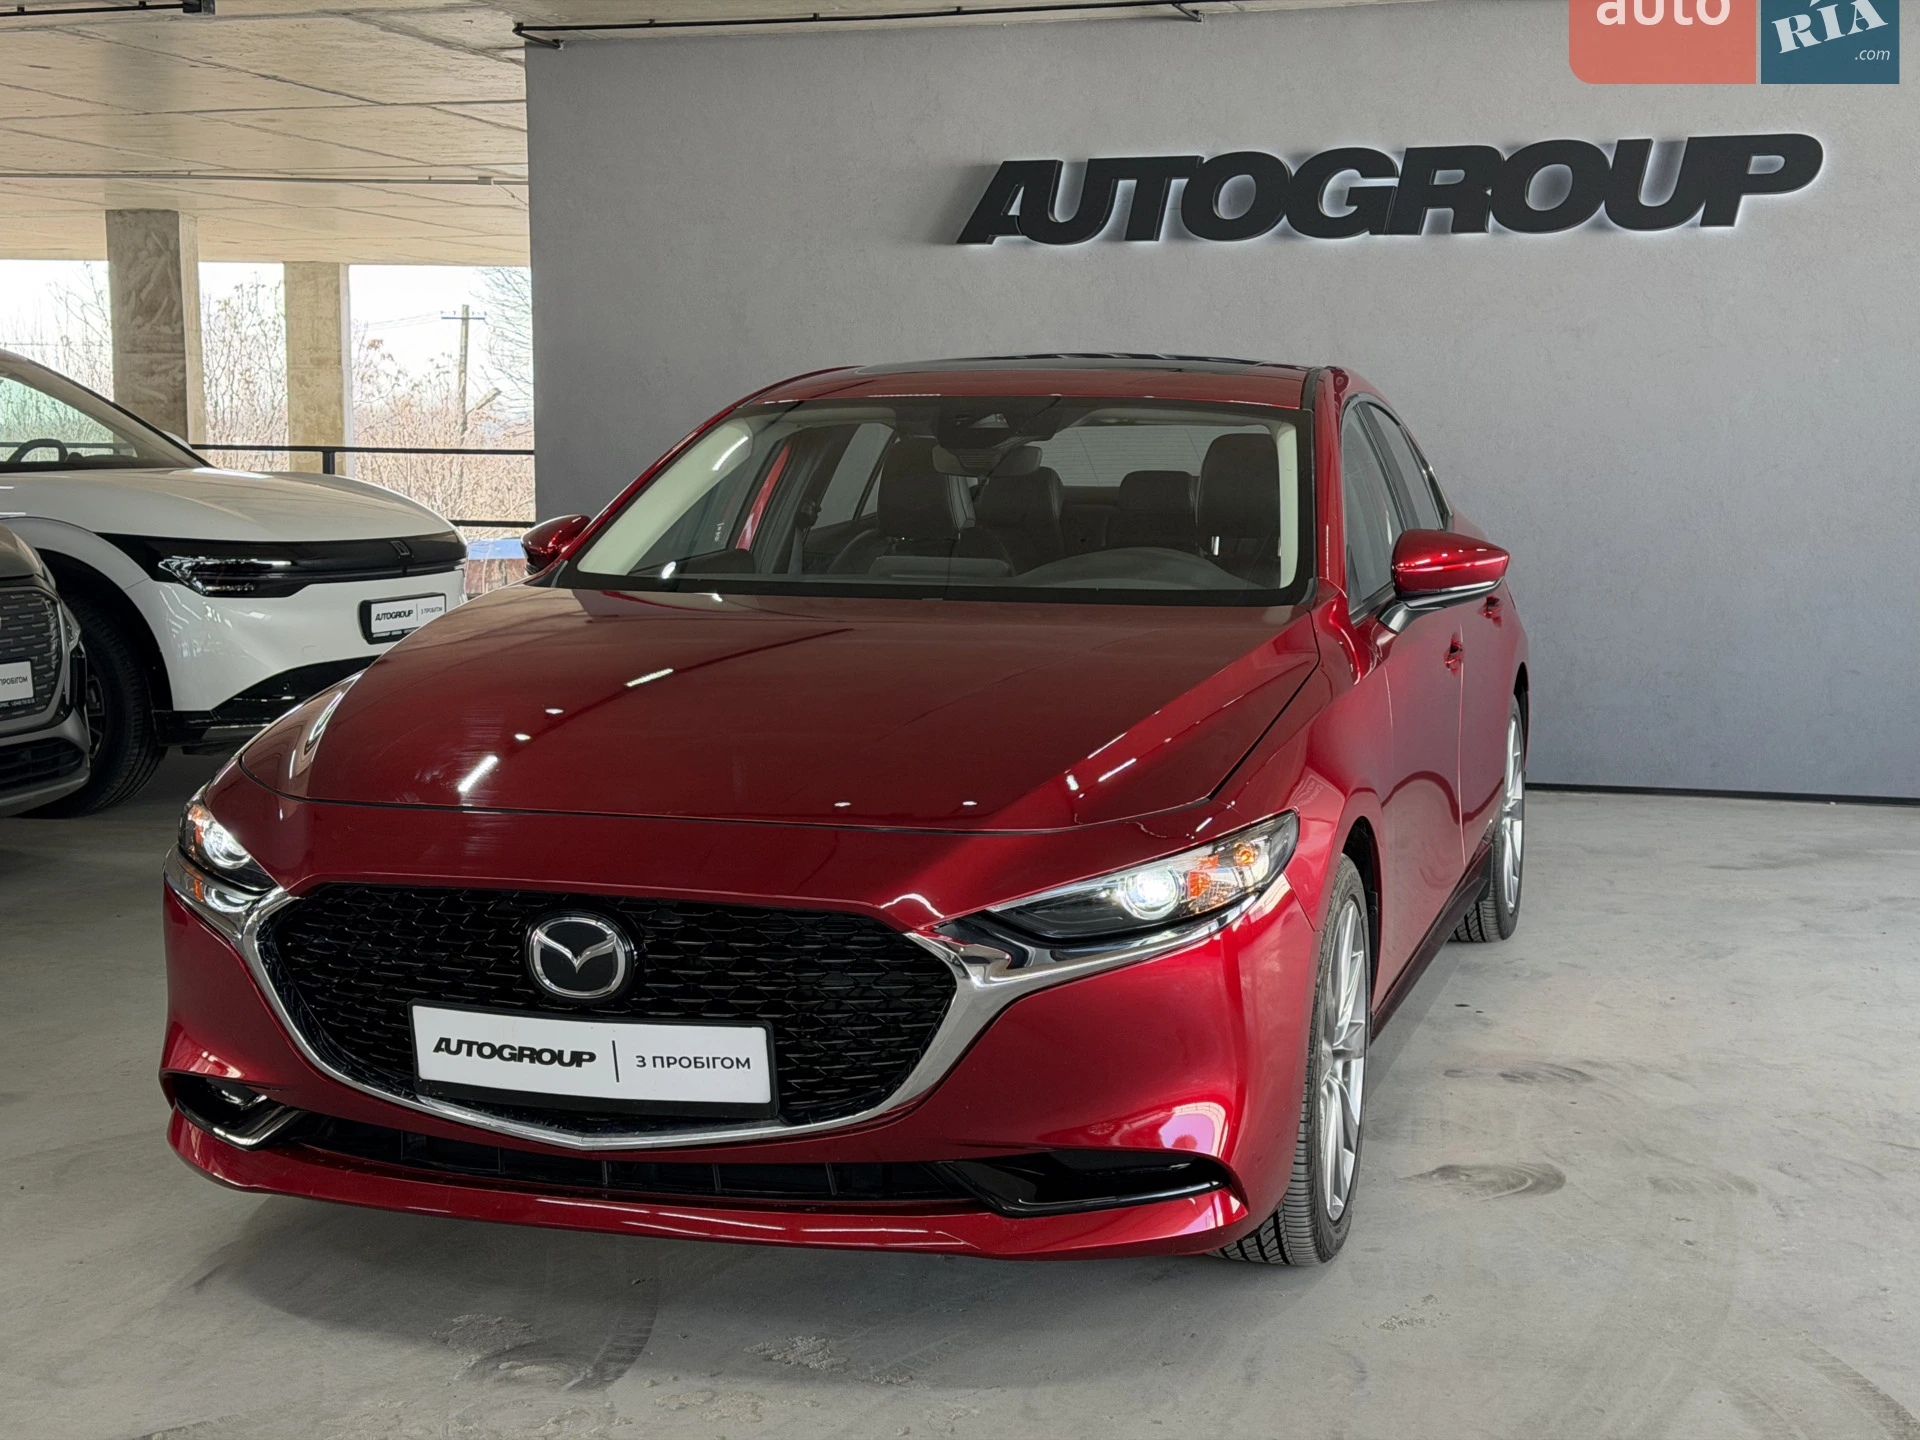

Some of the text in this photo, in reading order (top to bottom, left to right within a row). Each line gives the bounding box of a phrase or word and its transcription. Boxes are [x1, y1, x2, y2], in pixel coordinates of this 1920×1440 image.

[956, 134, 1823, 245] AUTOGROUP
[375, 609, 414, 621] AUTOGROUP
[433, 1037, 597, 1068] AUTOGROUP
[652, 1056, 751, 1070] ПРОБІГОМ
